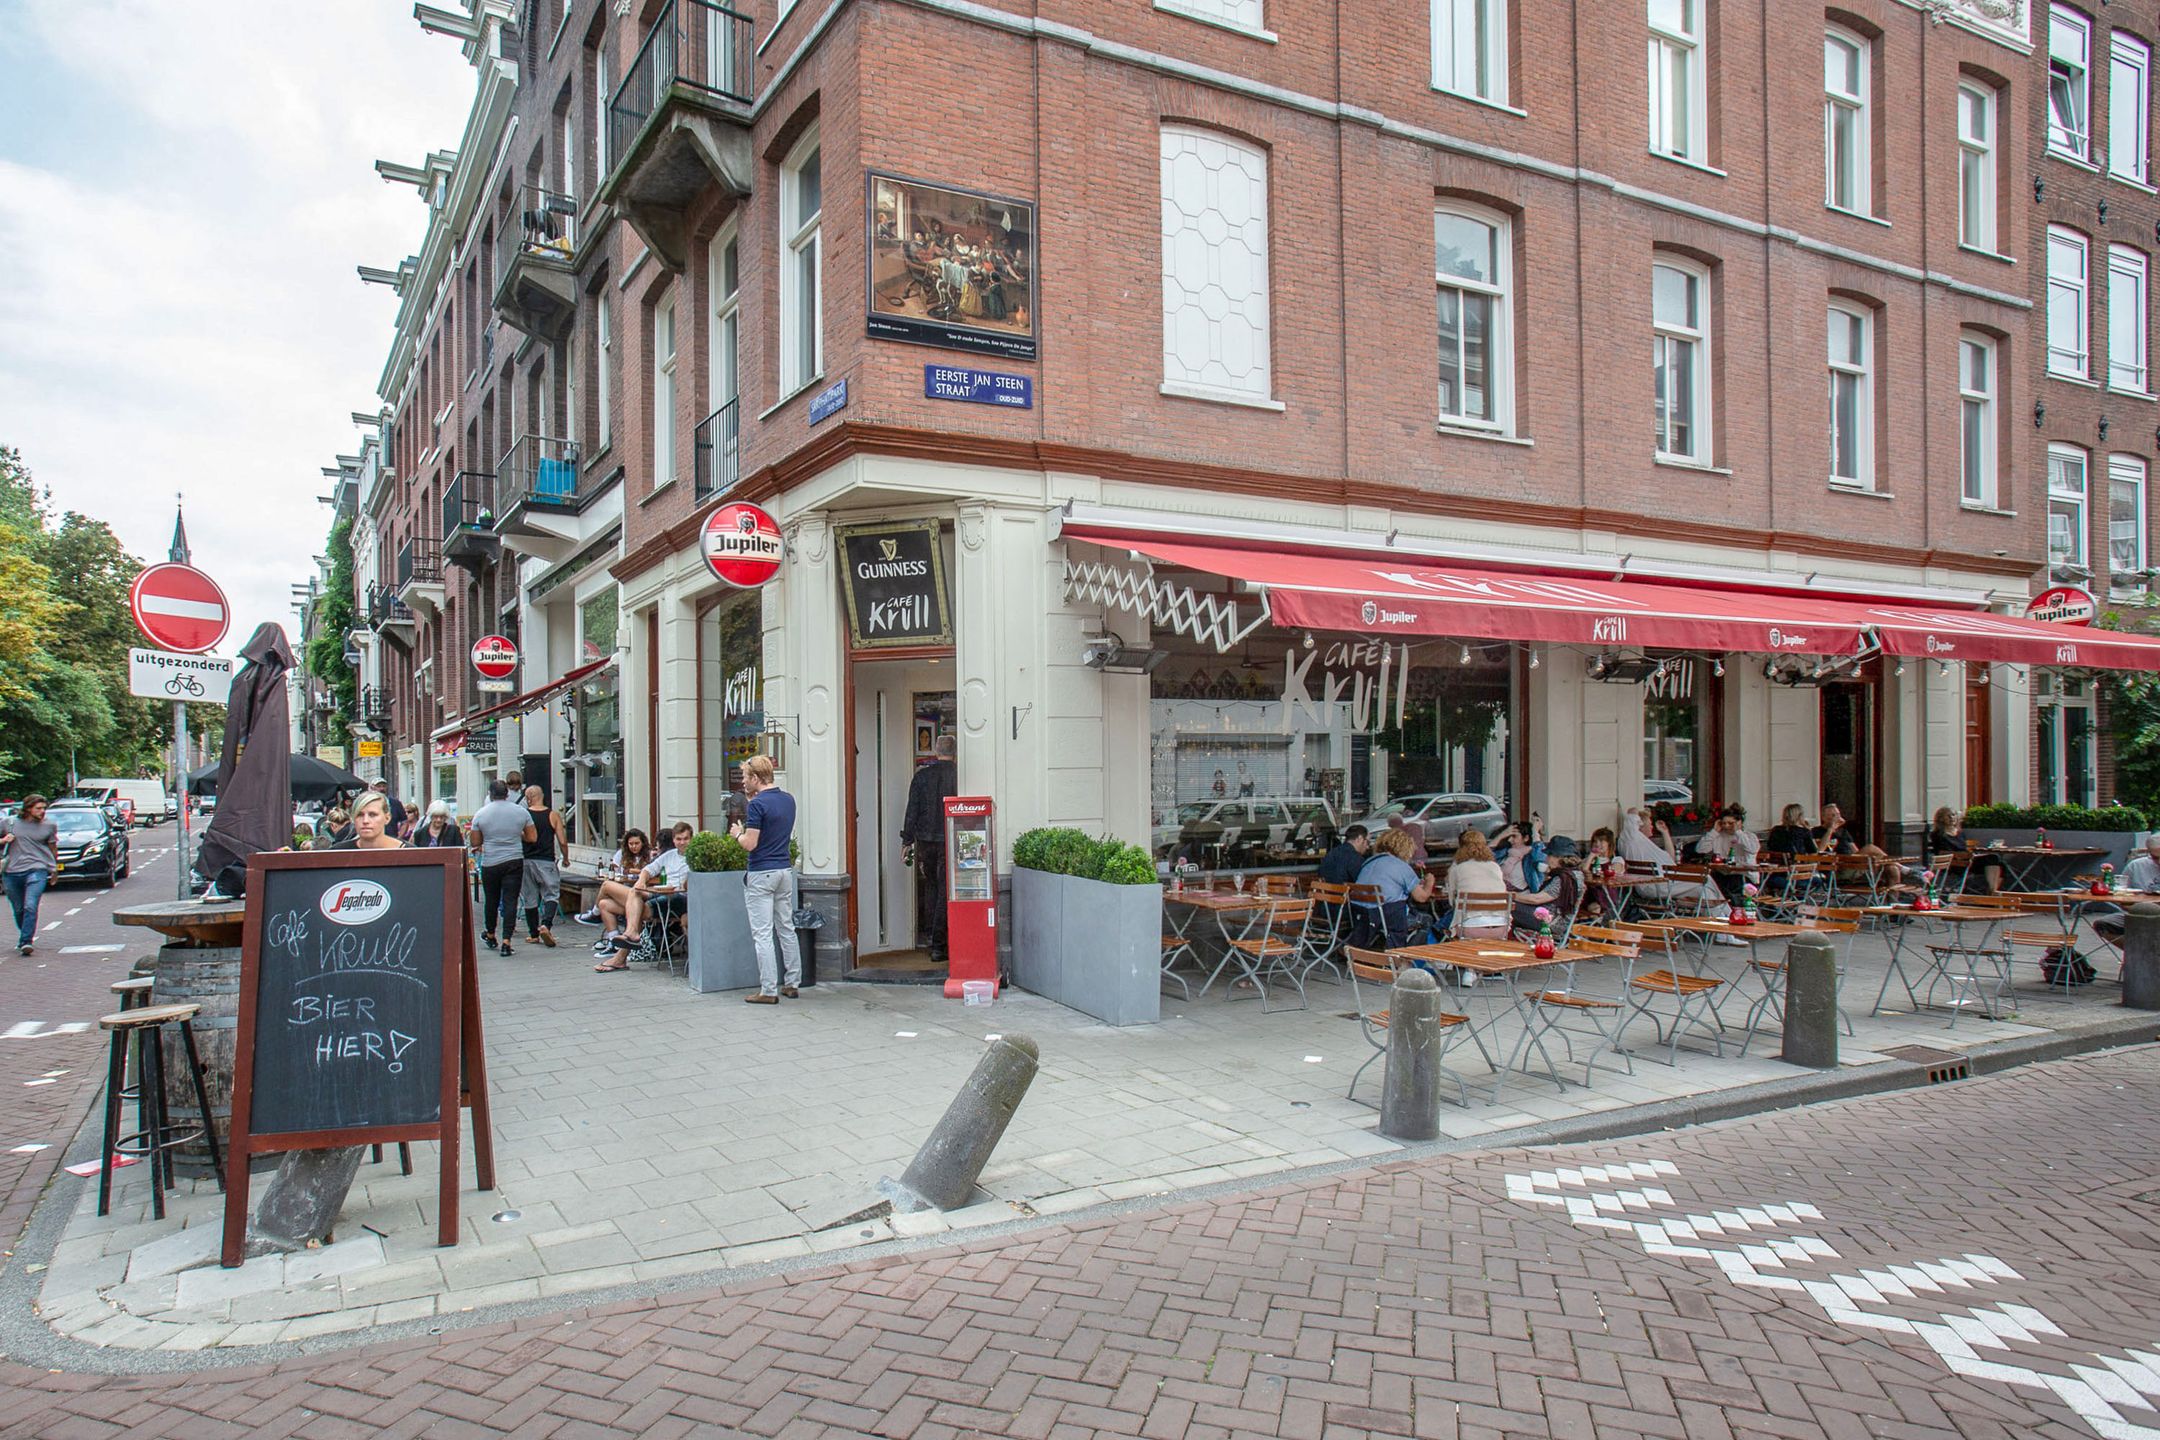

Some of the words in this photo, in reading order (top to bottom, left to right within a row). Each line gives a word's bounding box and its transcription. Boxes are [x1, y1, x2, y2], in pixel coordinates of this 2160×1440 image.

[935, 369, 969, 384] EERSTE
[974, 373, 991, 387] JAN
[995, 376, 1024, 391] STEEN
[935, 383, 971, 397] STRAAT
[713, 534, 779, 555] Jupiler
[857, 560, 928, 579] GUINNESS
[868, 594, 929, 634] Krull
[1380, 609, 1418, 625] Jupiler
[1593, 617, 1627, 641] Krull
[1782, 635, 1808, 647] Jupiler
[136, 653, 230, 672] uitgezonderd
[478, 651, 514, 662] Jupiler
[1323, 637, 1381, 669] CAFÉ
[723, 666, 756, 720] Krull
[1280, 641, 1409, 736] Krull
[329, 887, 383, 913] Segafredo
[268, 908, 311, 958] Café
